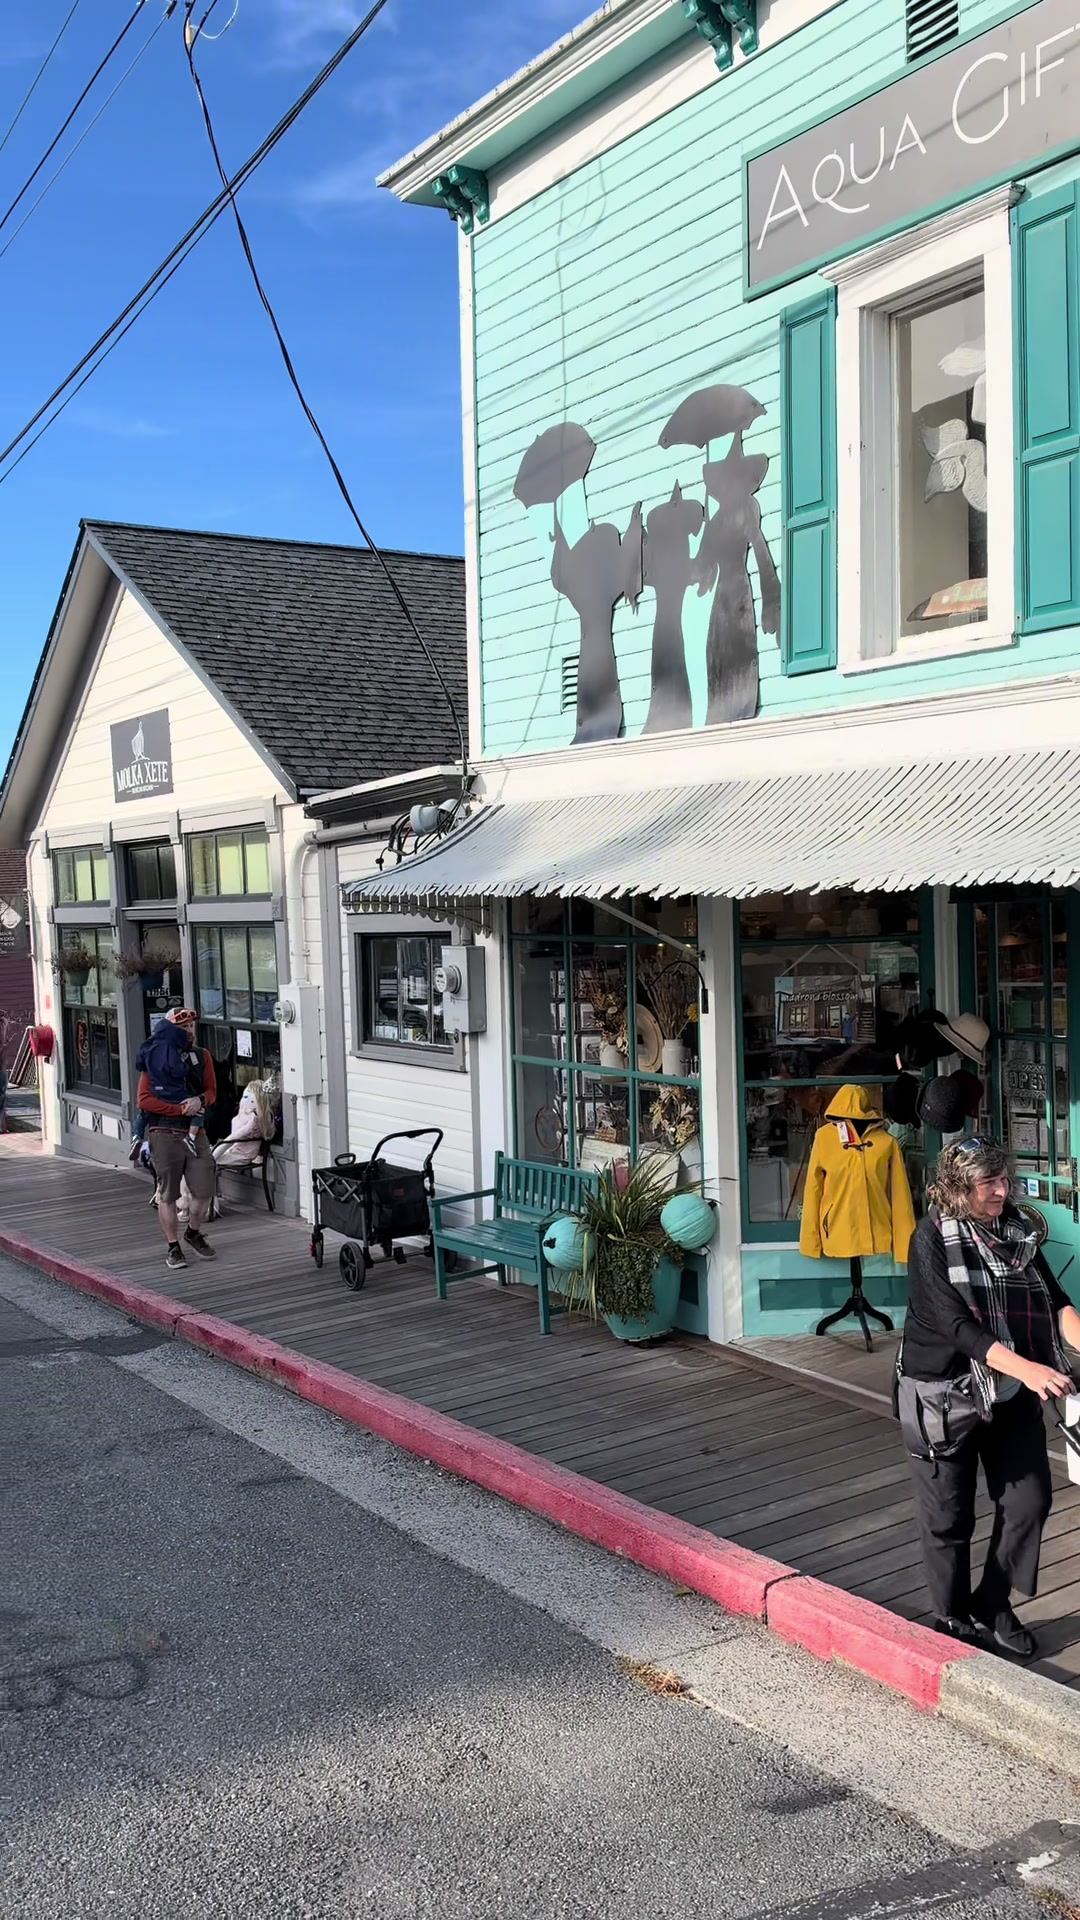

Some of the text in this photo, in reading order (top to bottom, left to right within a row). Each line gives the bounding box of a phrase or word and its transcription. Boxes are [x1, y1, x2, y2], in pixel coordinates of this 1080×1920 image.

[757, 22, 1080, 250] AQUA GIF
[116, 764, 143, 792] MOLKA
[145, 761, 169, 783] XETE
[822, 991, 858, 1001] blossom
